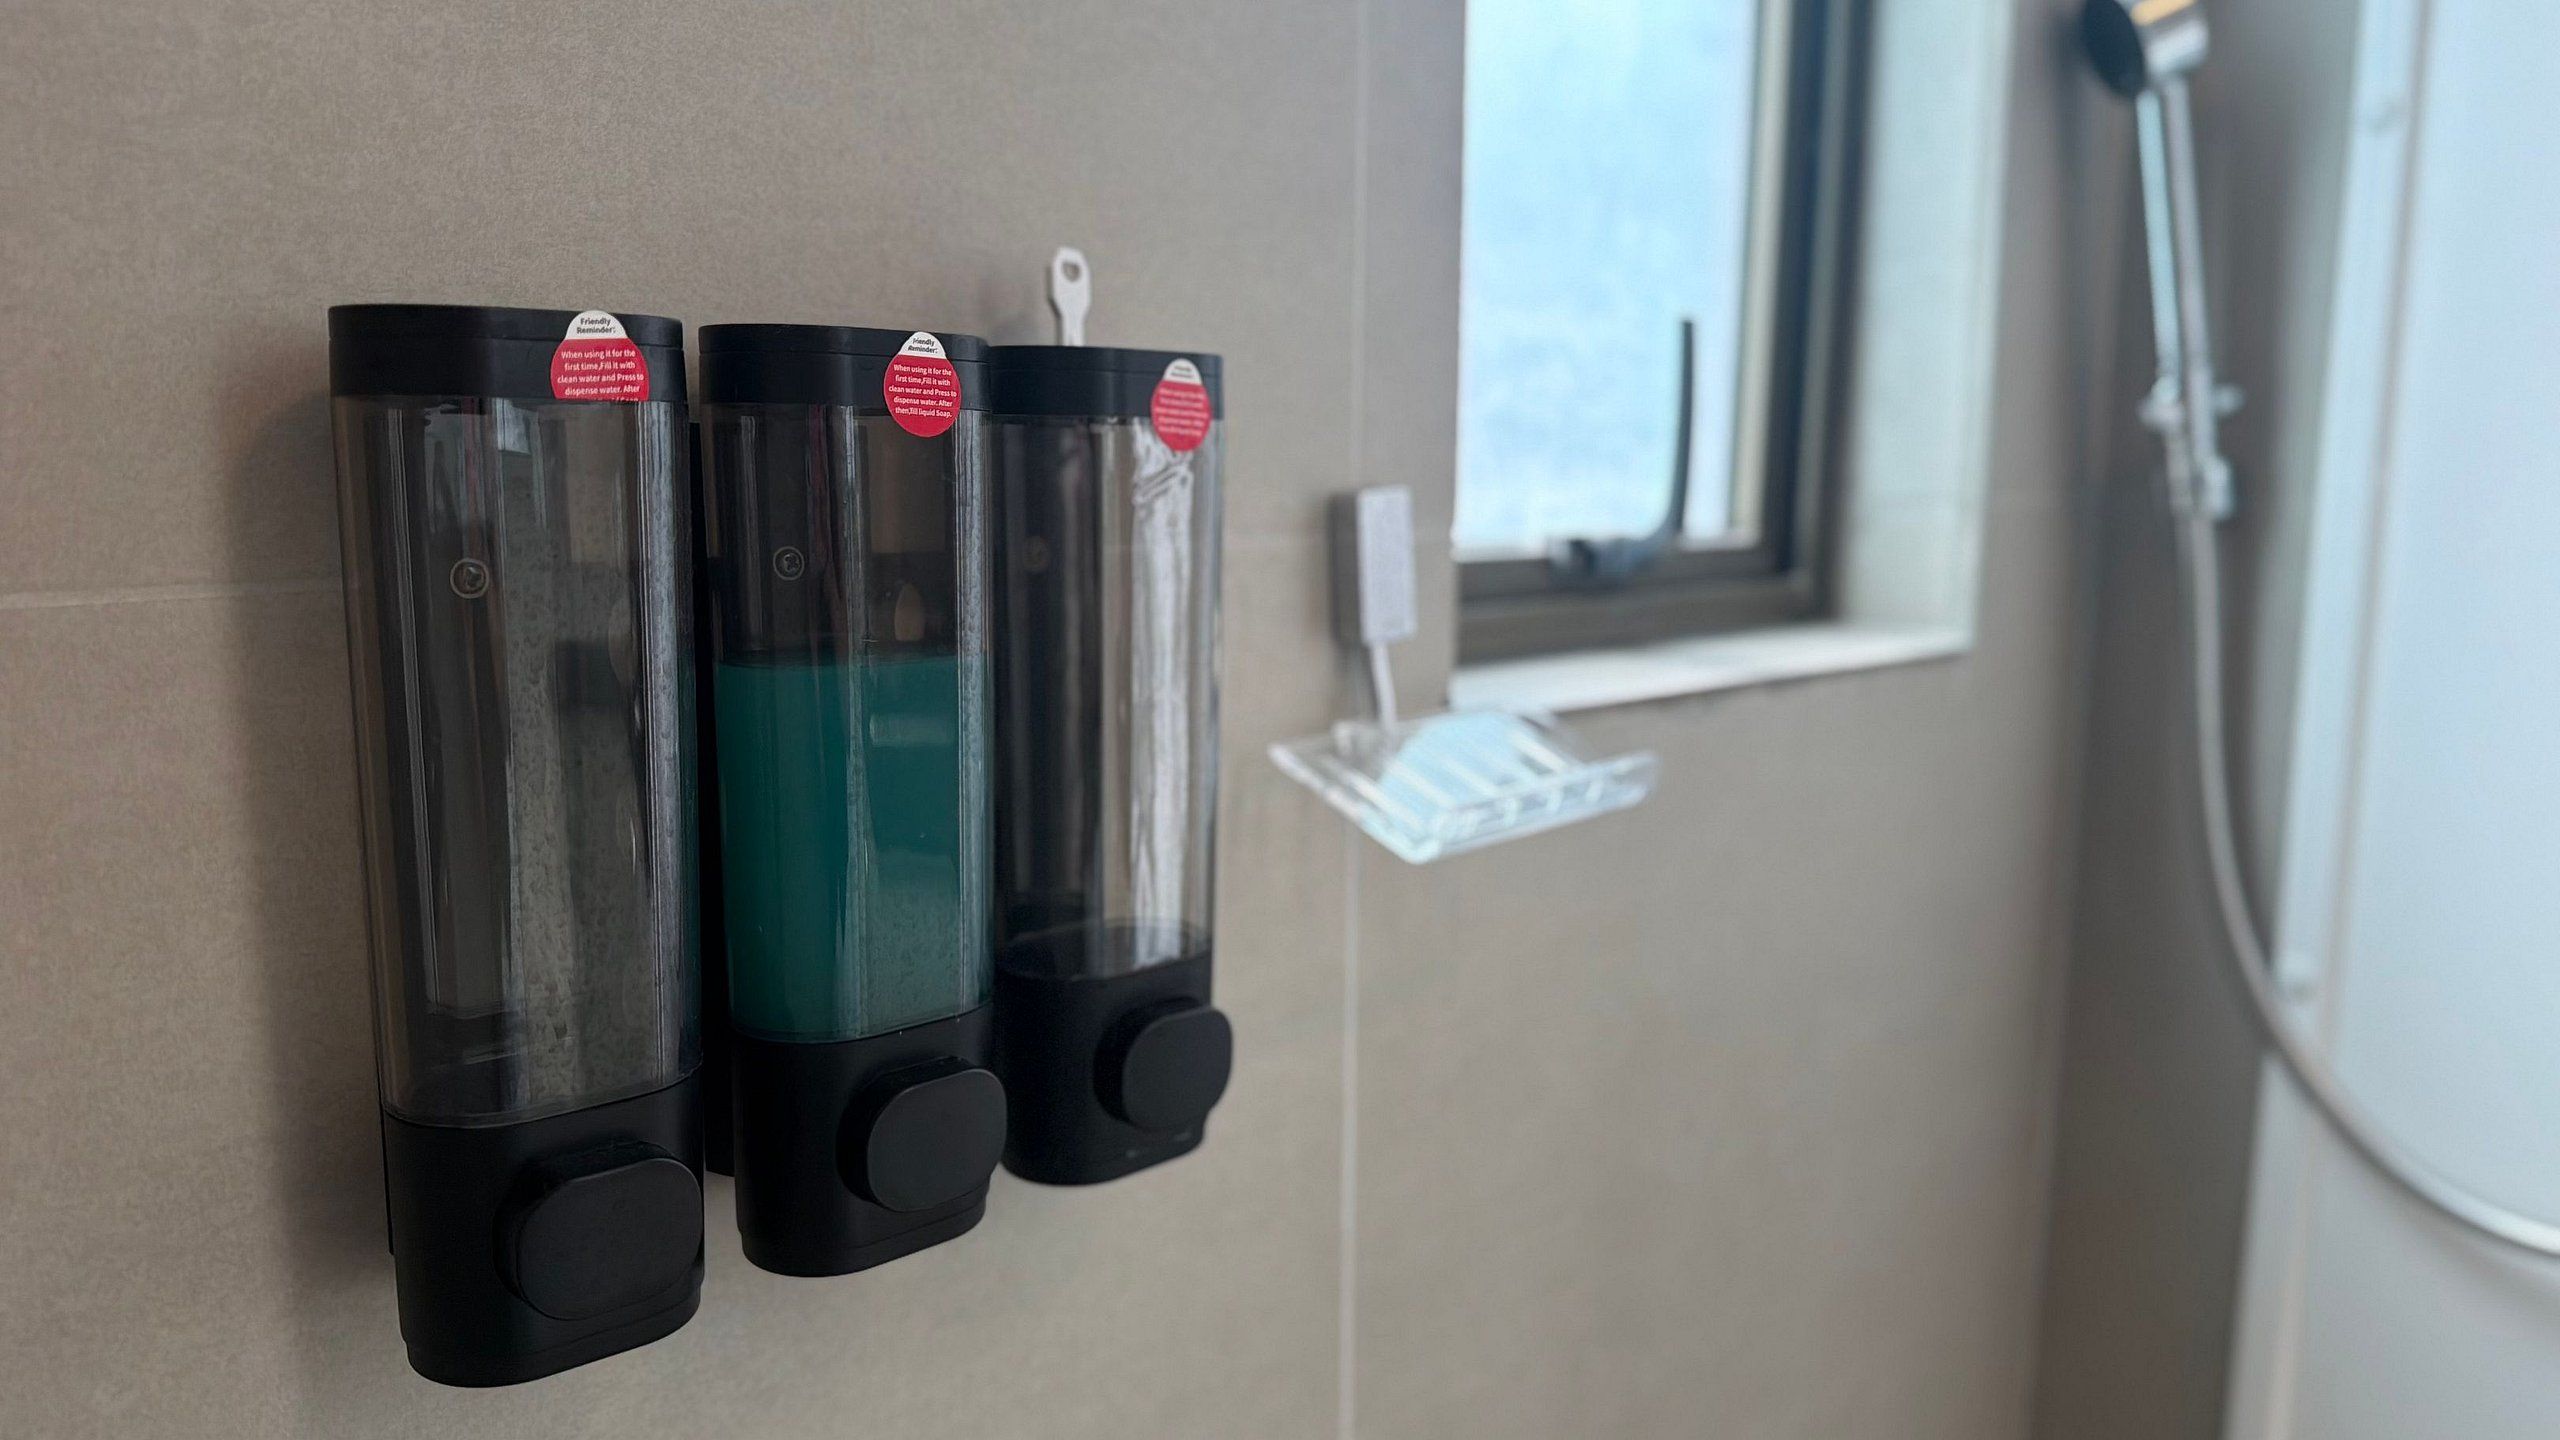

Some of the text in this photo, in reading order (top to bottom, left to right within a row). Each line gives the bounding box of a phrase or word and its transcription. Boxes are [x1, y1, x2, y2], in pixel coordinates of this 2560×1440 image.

[580, 318, 611, 326] Friendly
[913, 338, 934, 346] Friendly
[584, 351, 604, 359] using
[565, 363, 580, 371] first
[619, 361, 635, 369] with
[894, 364, 910, 372] When
[911, 366, 927, 375] using
[942, 368, 951, 376] the
[558, 375, 578, 383] clean
[601, 373, 615, 381] and
[616, 373, 636, 381] Press
[565, 387, 598, 396] dispense
[600, 386, 622, 394] water.
[889, 385, 904, 393] clean
[922, 387, 933, 395] and
[894, 396, 919, 405] dispense
[920, 398, 937, 406] water.
[919, 408, 935, 417] liquid
[936, 410, 952, 418] Soap.
